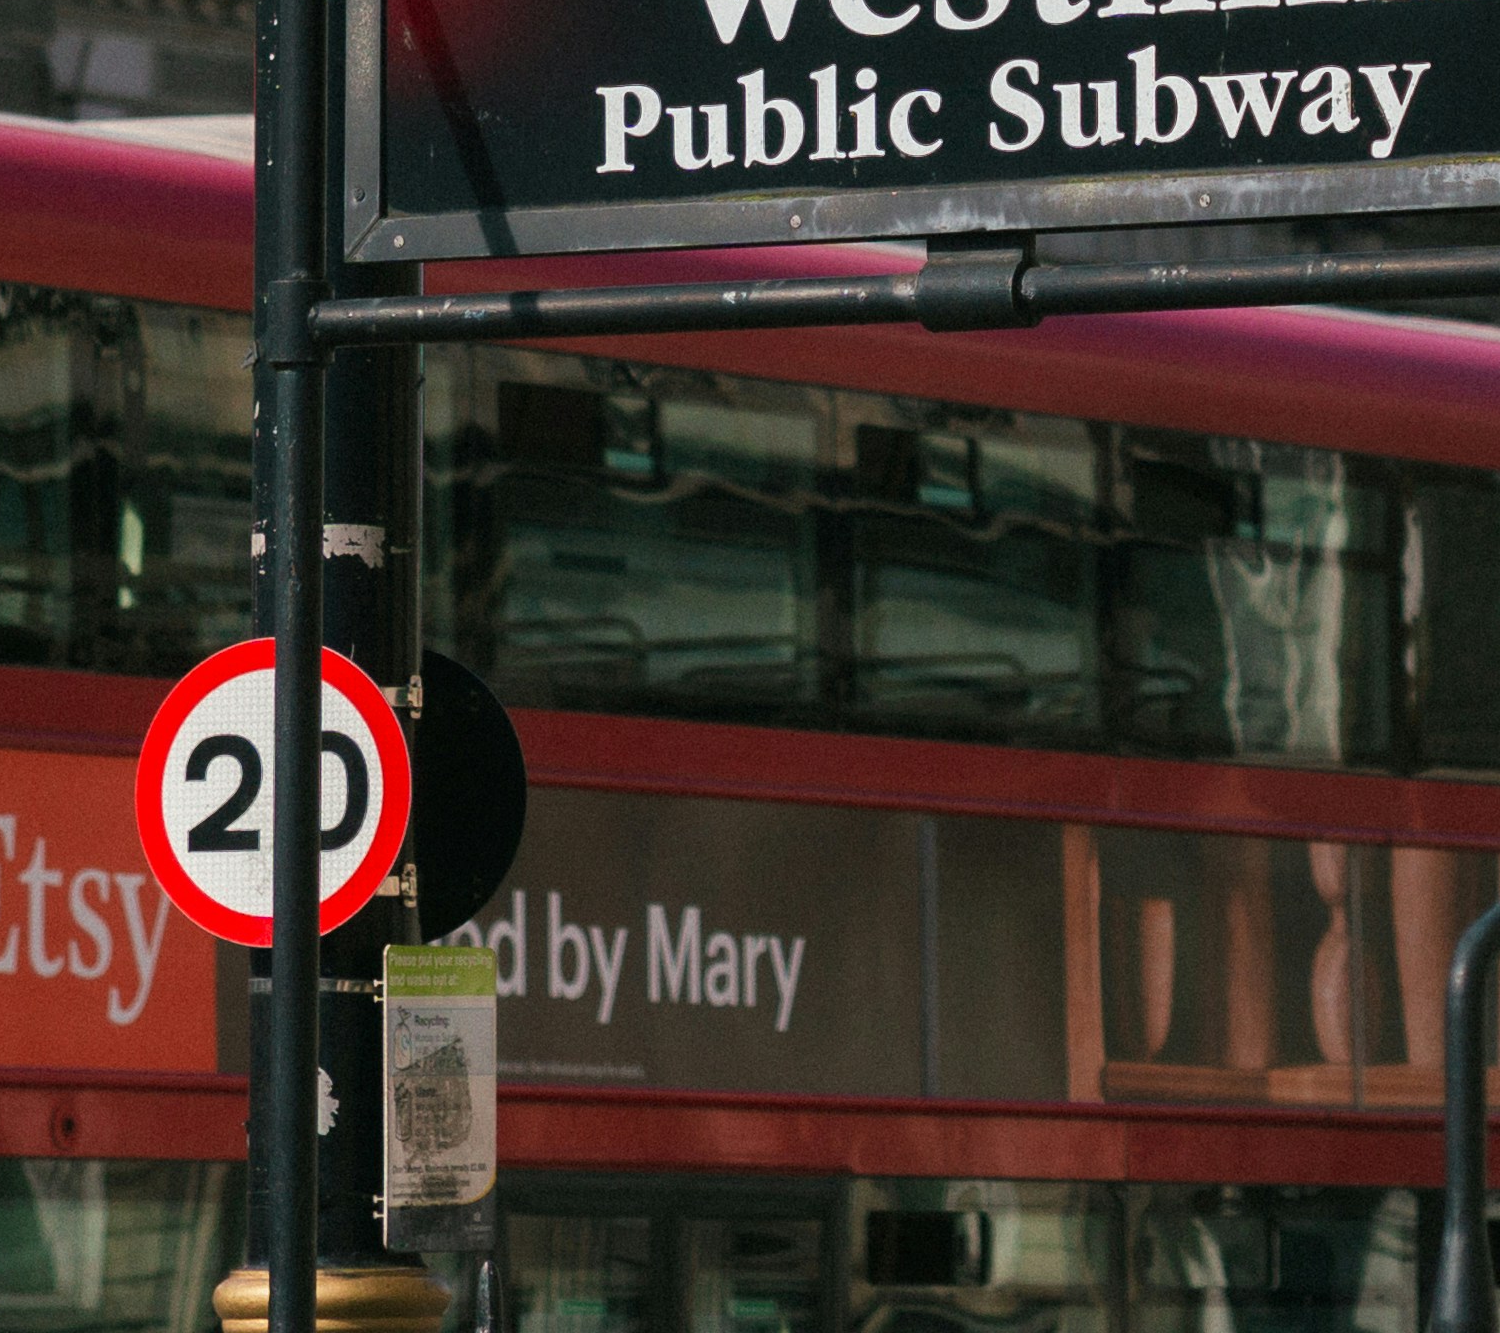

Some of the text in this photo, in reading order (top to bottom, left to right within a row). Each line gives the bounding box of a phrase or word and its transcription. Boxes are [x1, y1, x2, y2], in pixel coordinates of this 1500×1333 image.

[595, 44, 1432, 174] Public Subway
[548, 889, 629, 1025] by
[646, 904, 806, 1033] Mary
